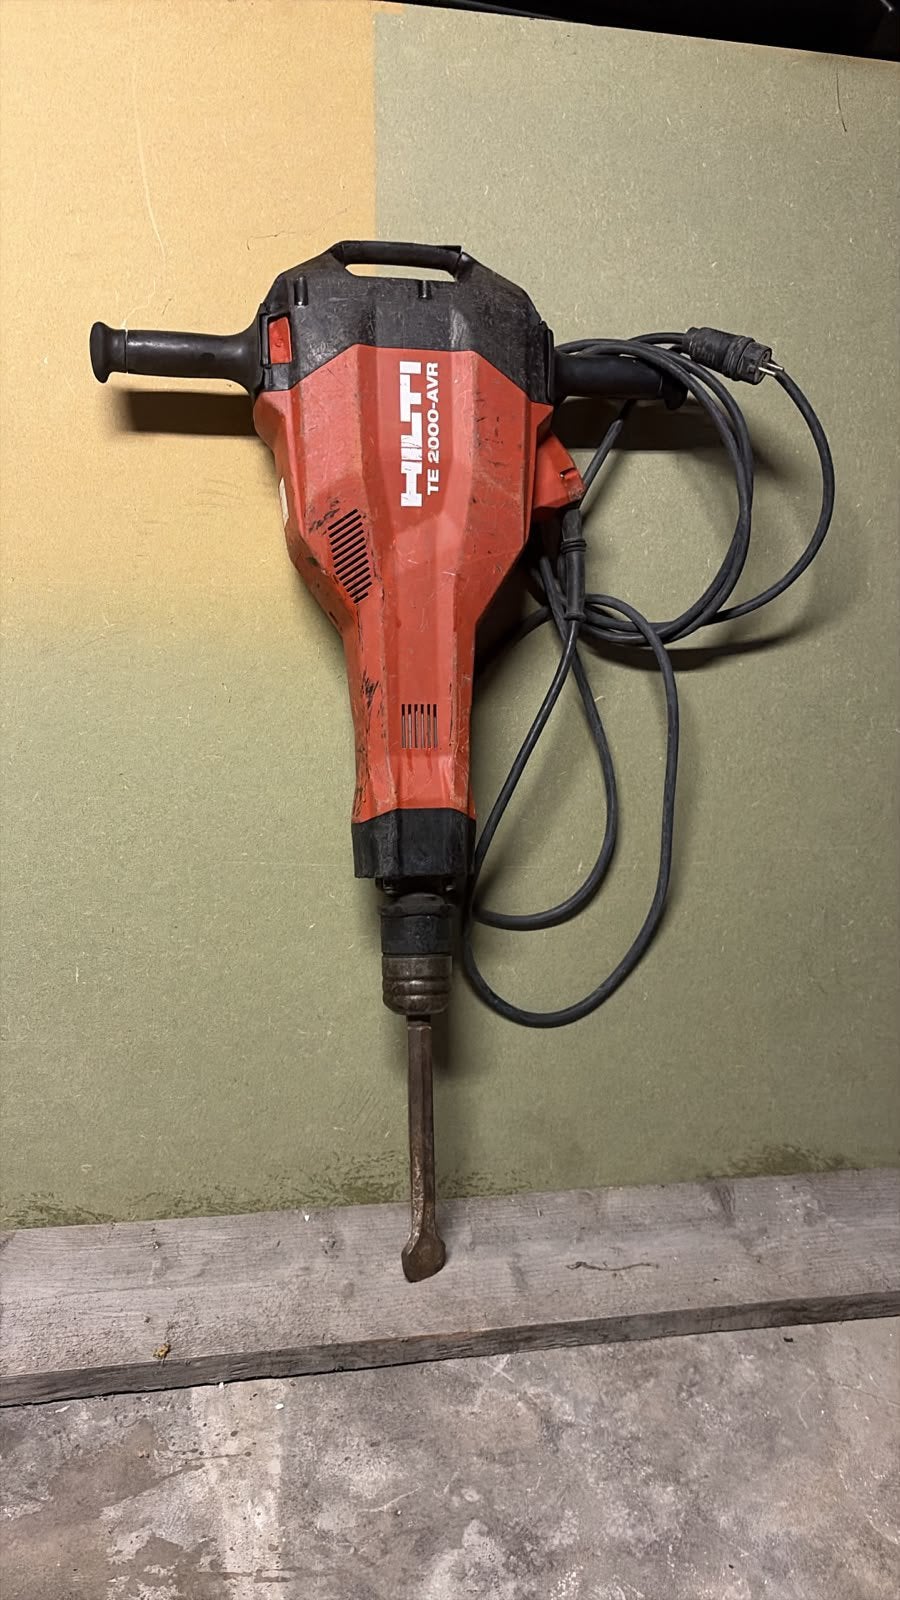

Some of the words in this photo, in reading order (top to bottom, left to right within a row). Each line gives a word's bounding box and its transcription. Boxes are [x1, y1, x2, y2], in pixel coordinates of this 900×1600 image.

[400, 361, 422, 507] HILTI
[426, 362, 439, 463] 2000-AVR
[427, 469, 439, 495] TE
